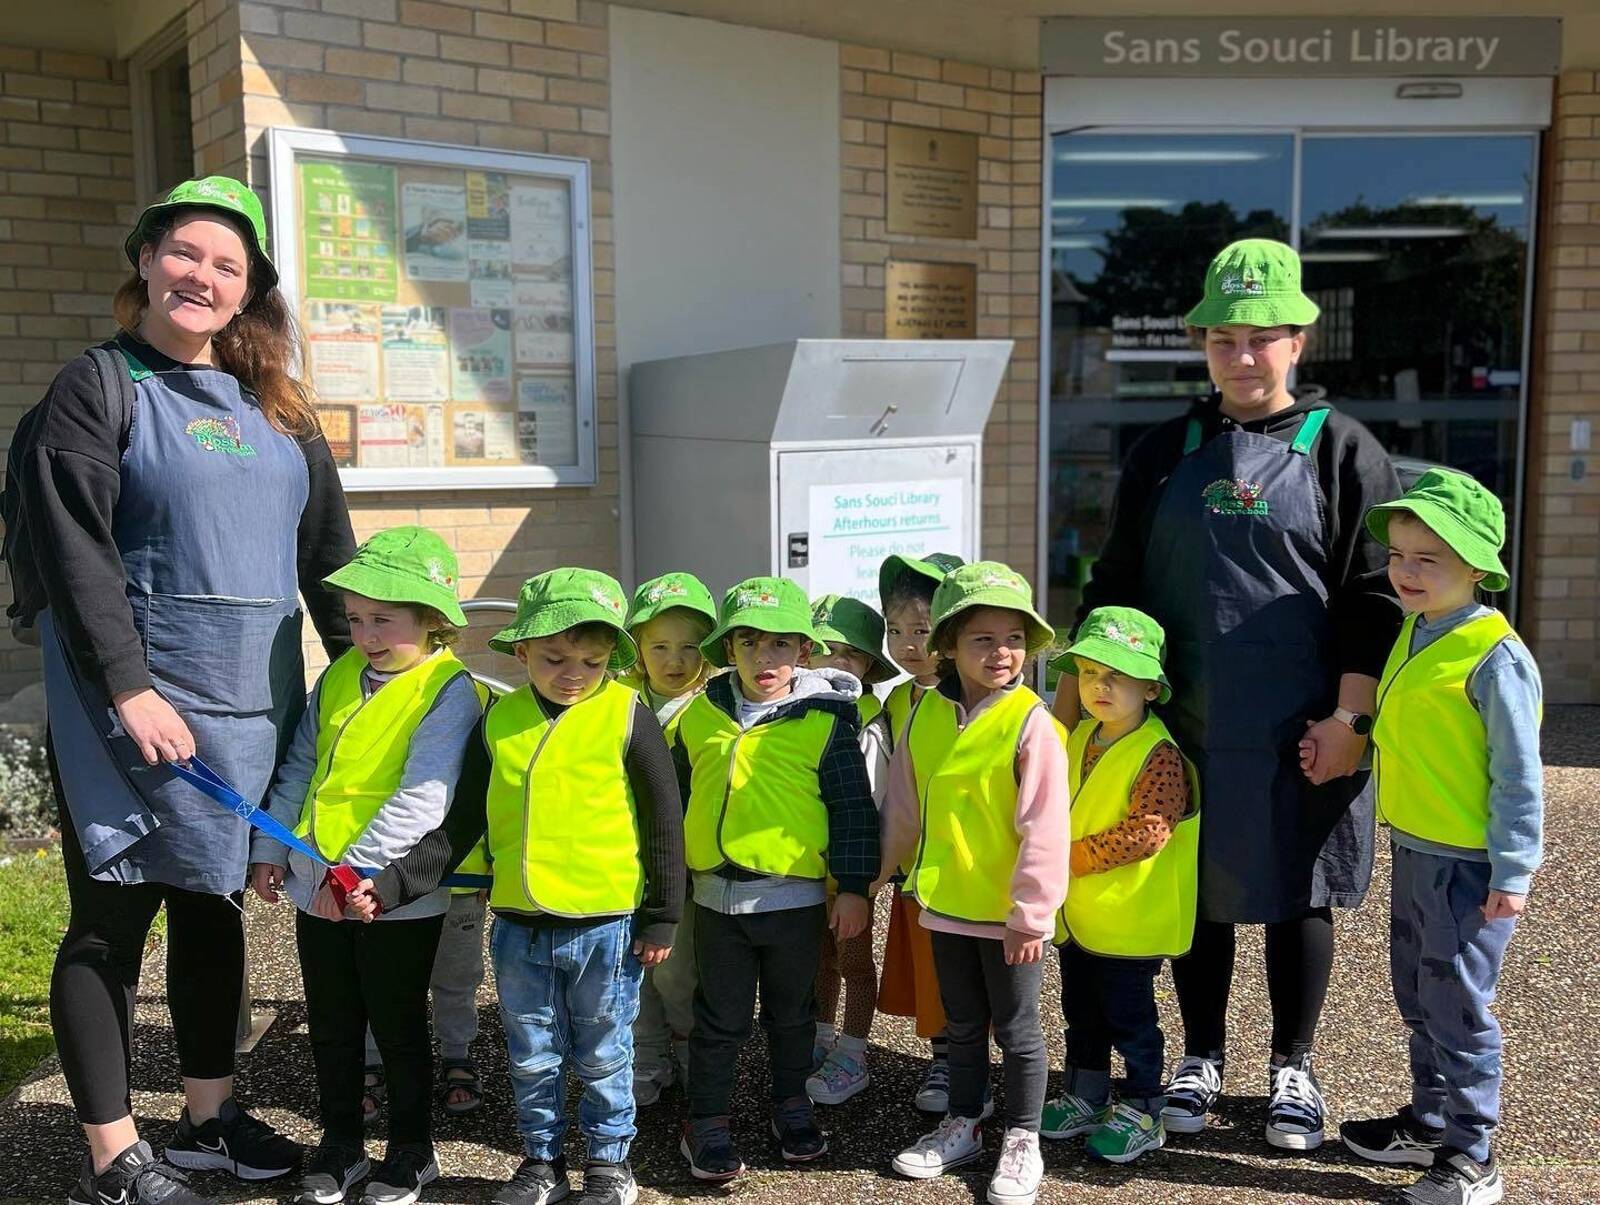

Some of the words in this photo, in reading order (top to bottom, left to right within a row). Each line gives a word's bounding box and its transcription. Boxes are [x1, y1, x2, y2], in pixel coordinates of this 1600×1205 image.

[1103, 30, 1201, 63] Sans
[1218, 29, 1333, 63] Souci
[1350, 28, 1500, 70] Library
[1111, 314, 1140, 330] Sans
[1143, 314, 1177, 330] Souci
[834, 495, 863, 509] Sans
[865, 492, 897, 508] Souci
[900, 491, 940, 507] Library
[833, 515, 897, 531] Afterhours
[900, 513, 941, 527] returns
[849, 544, 886, 558] Please
[889, 542, 904, 555] do
[906, 542, 925, 553] not
